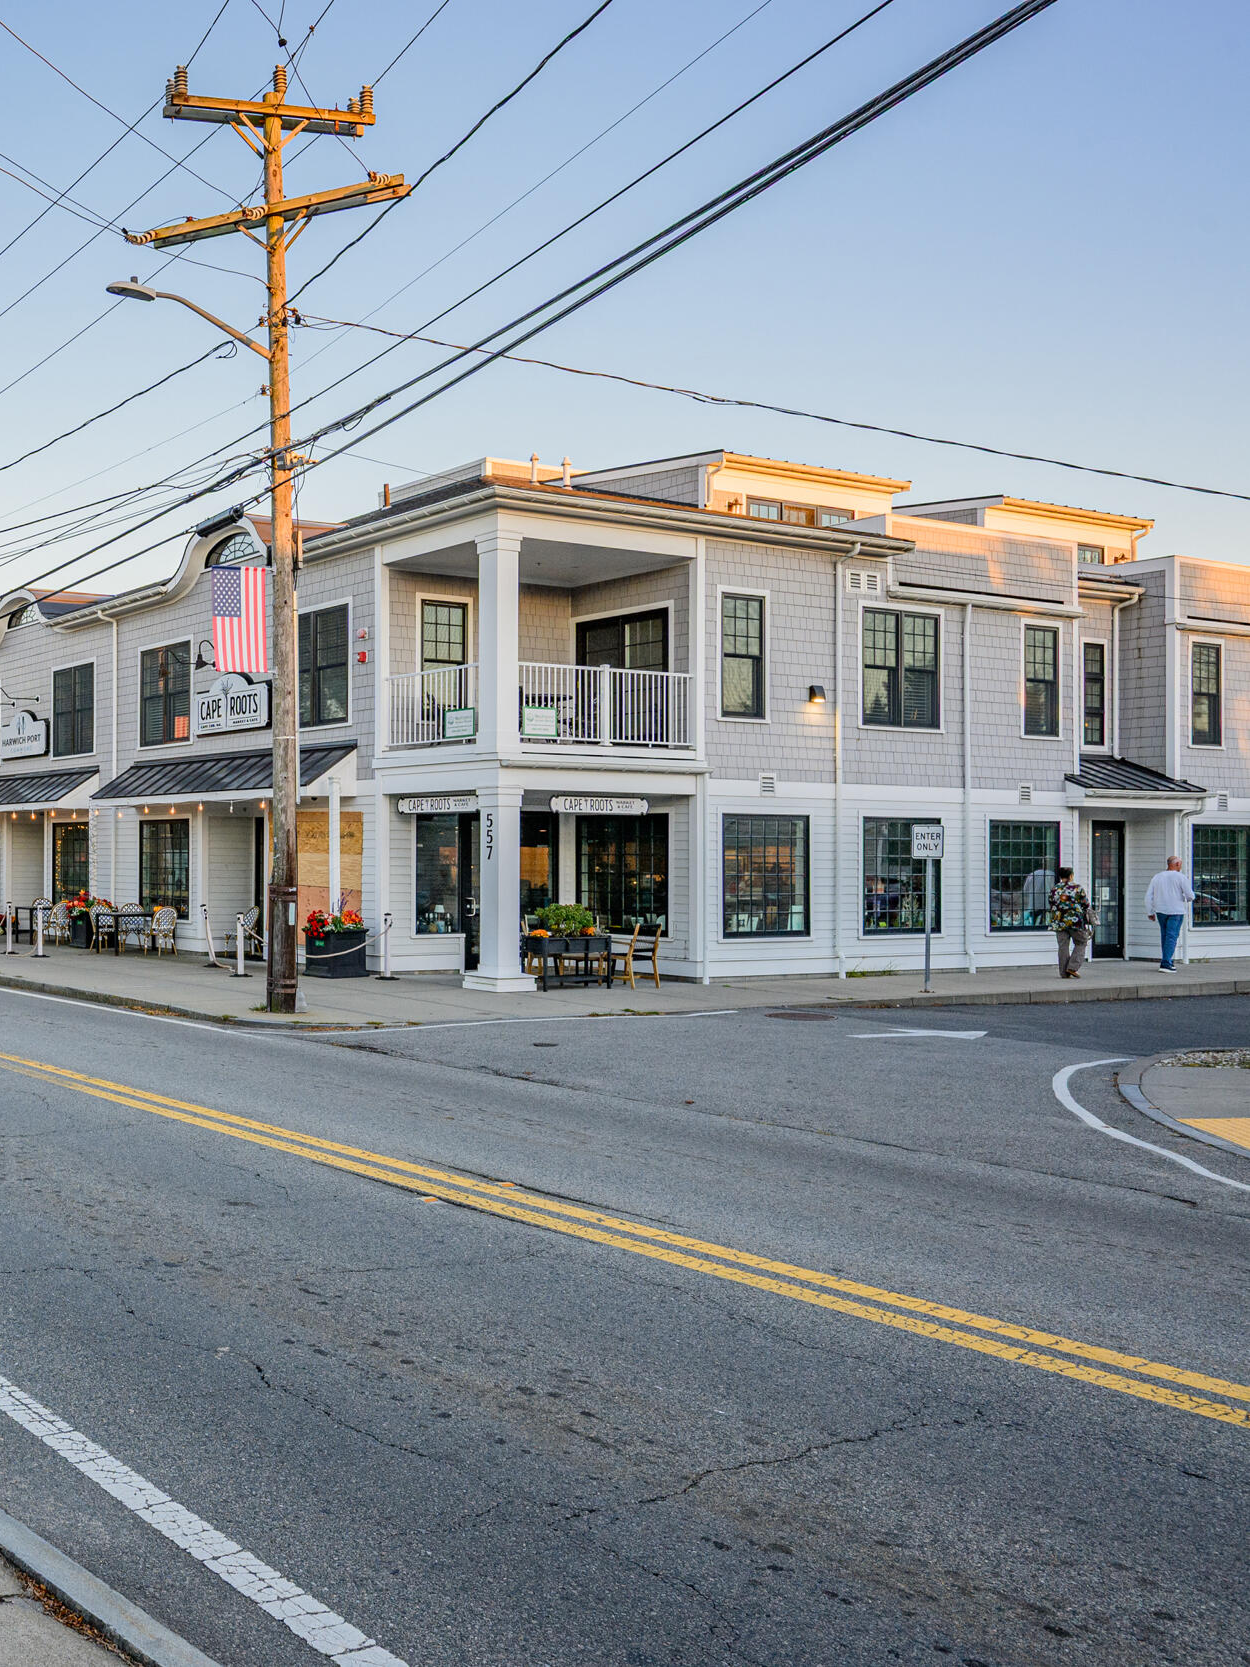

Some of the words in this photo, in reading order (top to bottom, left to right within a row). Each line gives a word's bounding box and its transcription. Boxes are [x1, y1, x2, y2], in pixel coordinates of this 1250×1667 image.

[200, 698, 222, 721] CAPE
[230, 693, 258, 717] ROOTS
[2, 736, 27, 747] HARWICH
[26, 734, 41, 744] PORT
[408, 798, 425, 812] CAPE
[430, 797, 451, 811] ROOTS
[563, 798, 582, 811] CAPE
[590, 799, 614, 812] ROOTS
[915, 833, 941, 841] ENTER
[917, 843, 940, 851] ONLY
